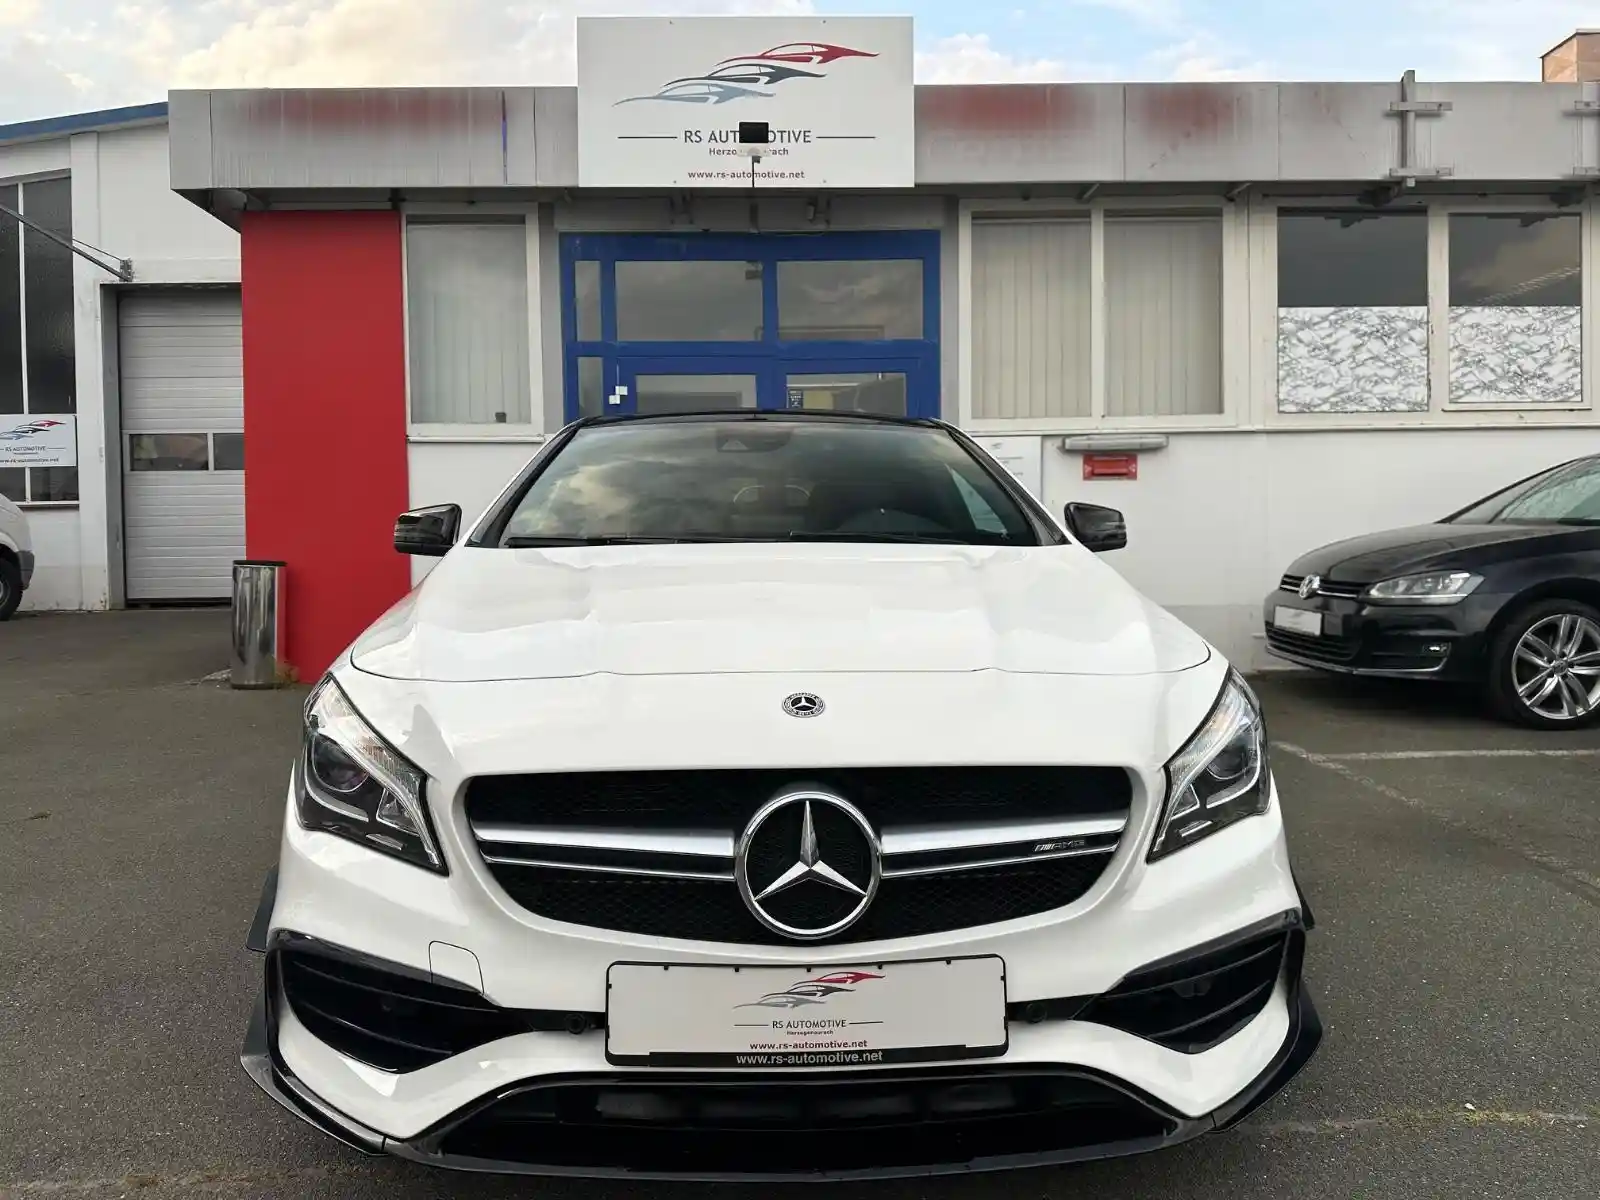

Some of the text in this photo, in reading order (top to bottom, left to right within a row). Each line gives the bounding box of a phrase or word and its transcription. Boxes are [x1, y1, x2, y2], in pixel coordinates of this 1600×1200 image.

[684, 130, 811, 143] RS AUTOTIVE
[688, 171, 805, 179] www.rs-automotive.net
[772, 1019, 847, 1029] RS AUTOMOTIVE
[750, 1040, 868, 1050] www.rs-automotive.net
[736, 1051, 883, 1065] www.rs-automotive.net
